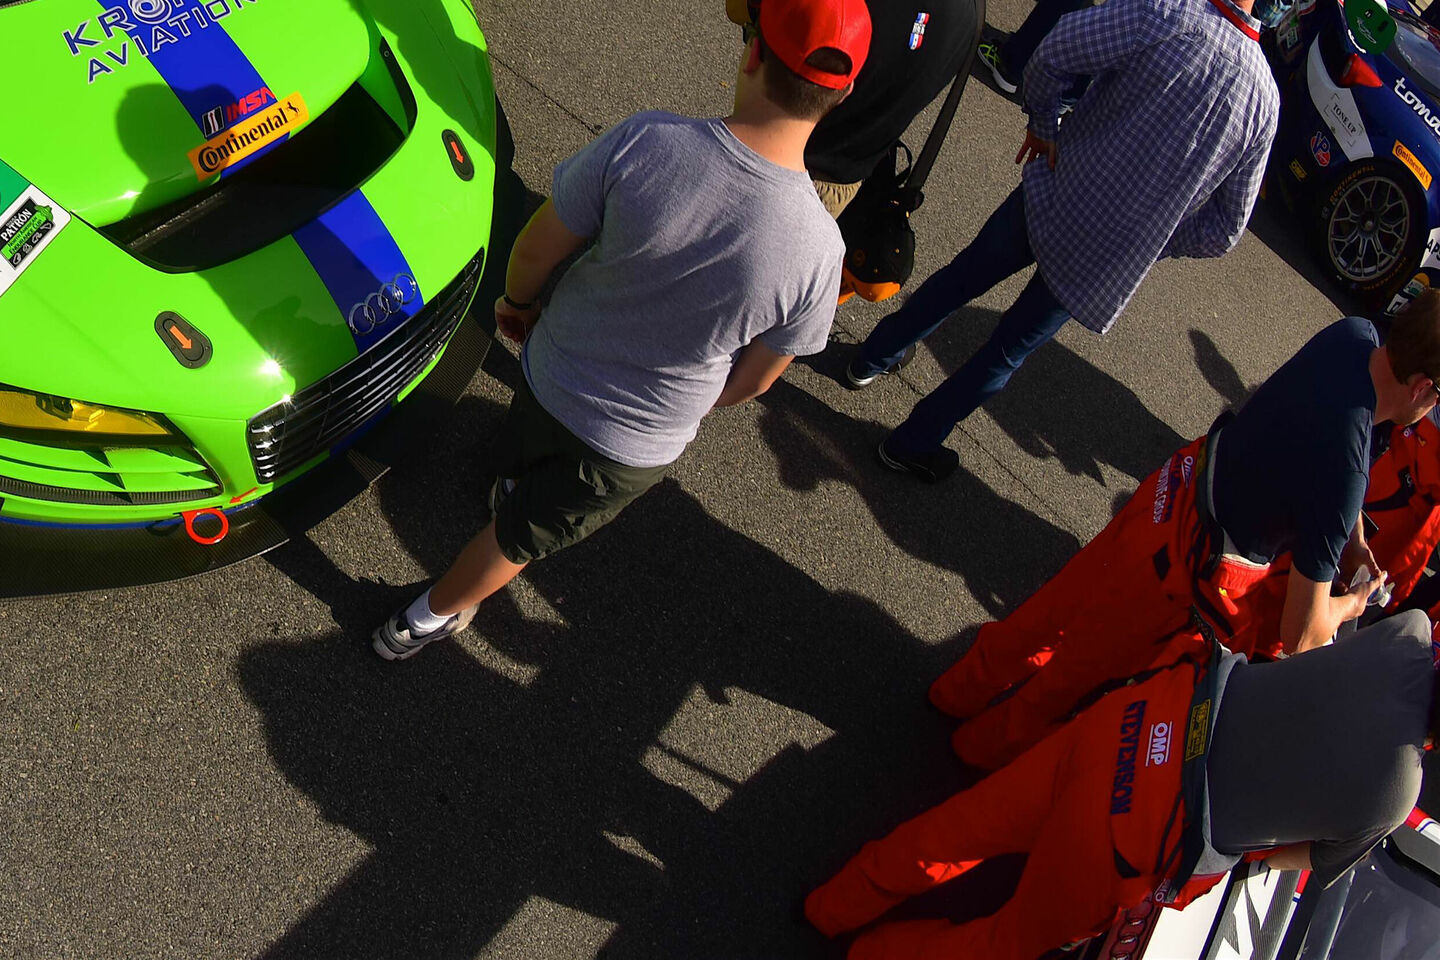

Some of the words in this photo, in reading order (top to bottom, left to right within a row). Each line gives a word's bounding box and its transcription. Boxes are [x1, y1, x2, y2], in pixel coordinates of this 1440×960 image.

[226, 86, 277, 123] IMSA
[1332, 103, 1347, 123] TONE
[1346, 123, 1357, 134] UP
[197, 107, 290, 173] Continental
[1394, 144, 1426, 180] Continental
[0, 208, 33, 242] PATRÓN
[1110, 699, 1147, 816] STEVENSON
[1150, 722, 1169, 766] OMP
